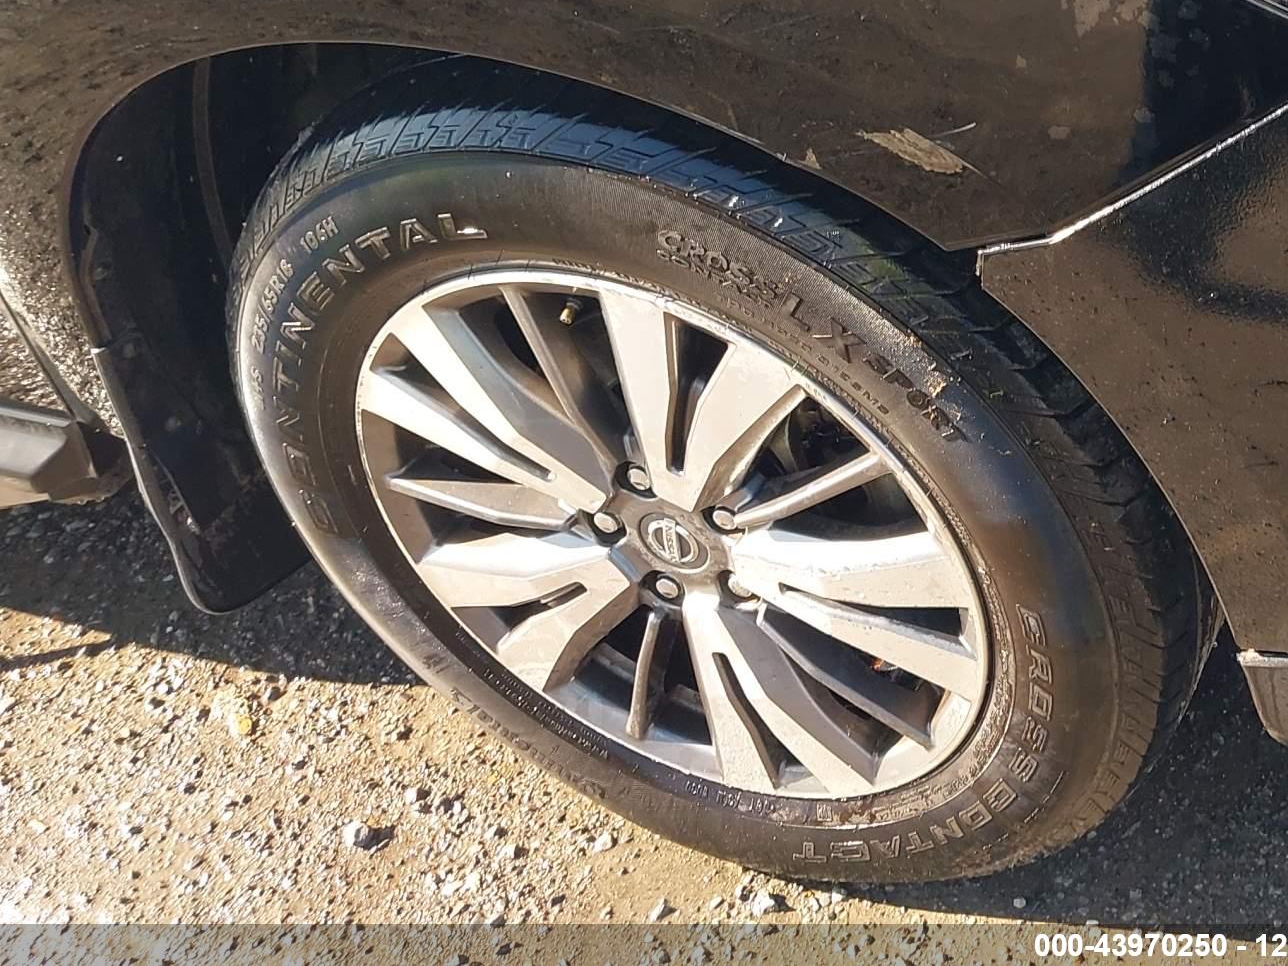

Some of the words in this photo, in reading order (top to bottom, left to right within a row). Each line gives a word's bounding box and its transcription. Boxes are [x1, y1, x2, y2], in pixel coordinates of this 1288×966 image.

[251, 258, 294, 355] 235/65R18
[300, 215, 339, 253] 106H
[658, 229, 778, 300] CROSS
[780, 291, 868, 365] LX
[272, 213, 488, 535] CONTINENTAL
[1008, 603, 1055, 784] CROSS
[792, 777, 1018, 864] CONTACT
